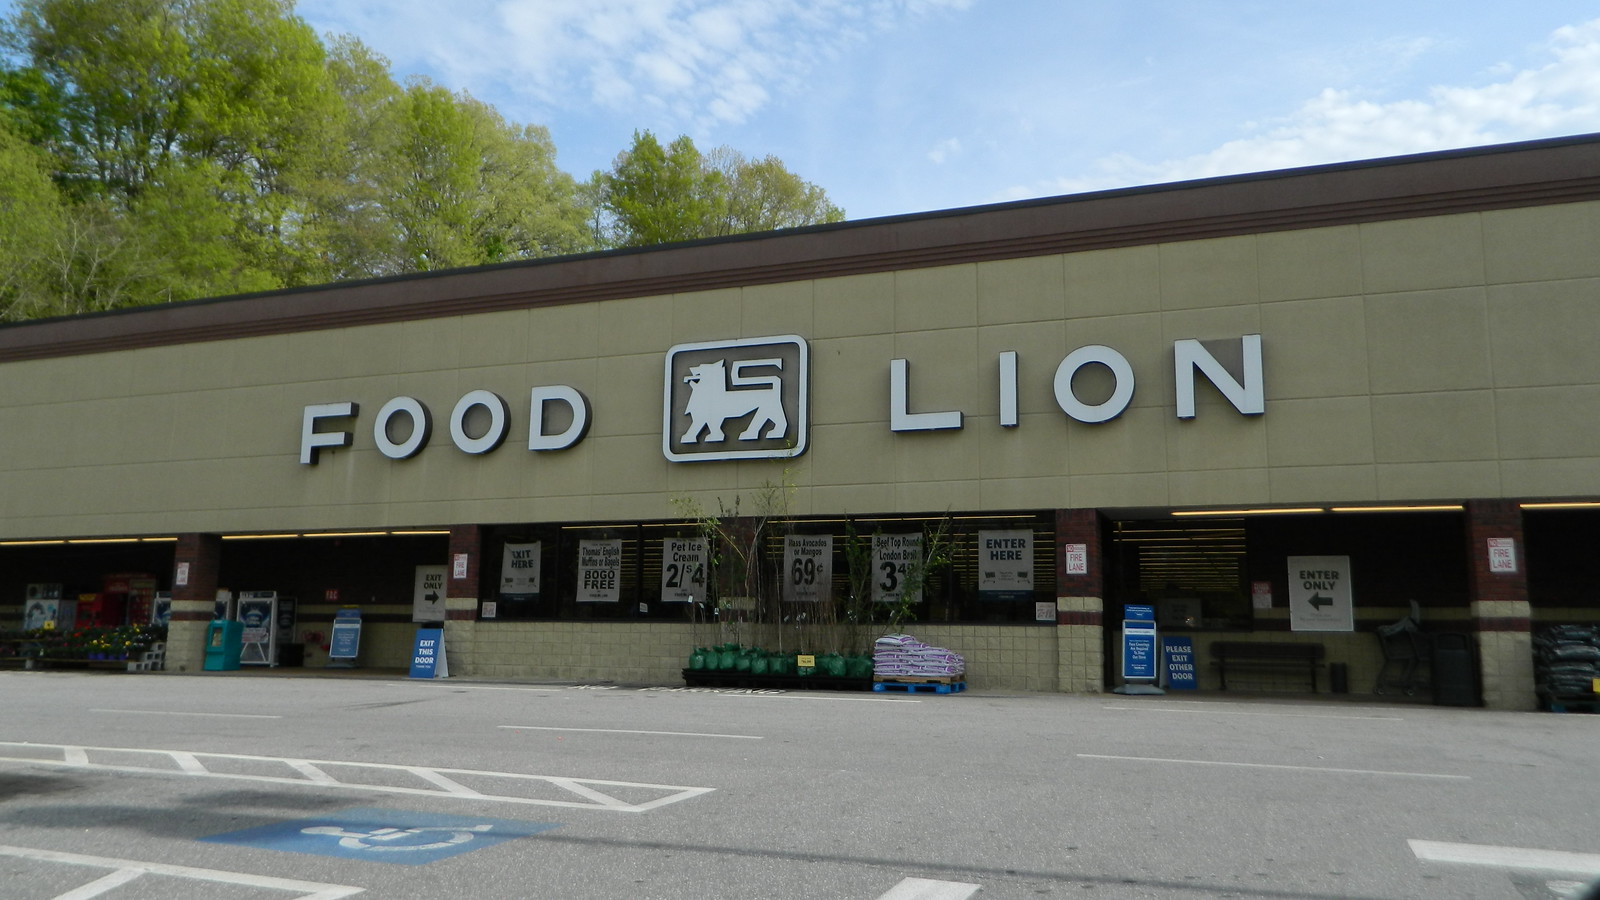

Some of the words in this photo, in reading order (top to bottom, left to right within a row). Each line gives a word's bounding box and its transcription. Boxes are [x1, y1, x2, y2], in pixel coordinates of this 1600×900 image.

[300, 385, 592, 465] FOOD
[890, 333, 1265, 433] LION
[671, 542, 686, 551] Pet
[688, 542, 702, 551] Ice
[802, 538, 827, 547] Avocados
[890, 537, 901, 549] Top
[986, 538, 1026, 549] ENTER
[602, 546, 620, 558] English
[673, 552, 699, 562] Cream
[801, 547, 822, 558] Mangos
[879, 550, 902, 560] London
[990, 550, 1022, 561] HERE
[1493, 549, 1509, 558] FIRE
[1069, 553, 1082, 562] FIRE
[511, 559, 534, 569] HERE
[1068, 563, 1084, 571] LANE
[1492, 559, 1512, 569] LANE
[584, 570, 615, 580] BOGO
[1299, 570, 1339, 580] ENTER
[424, 582, 443, 590] ONLY
[584, 580, 615, 590] FREE
[1302, 580, 1335, 590] ONLY
[419, 640, 435, 648] EXIT
[418, 648, 434, 656] THIS
[415, 656, 434, 664] DOOR
[1169, 663, 1193, 671] OTHER
